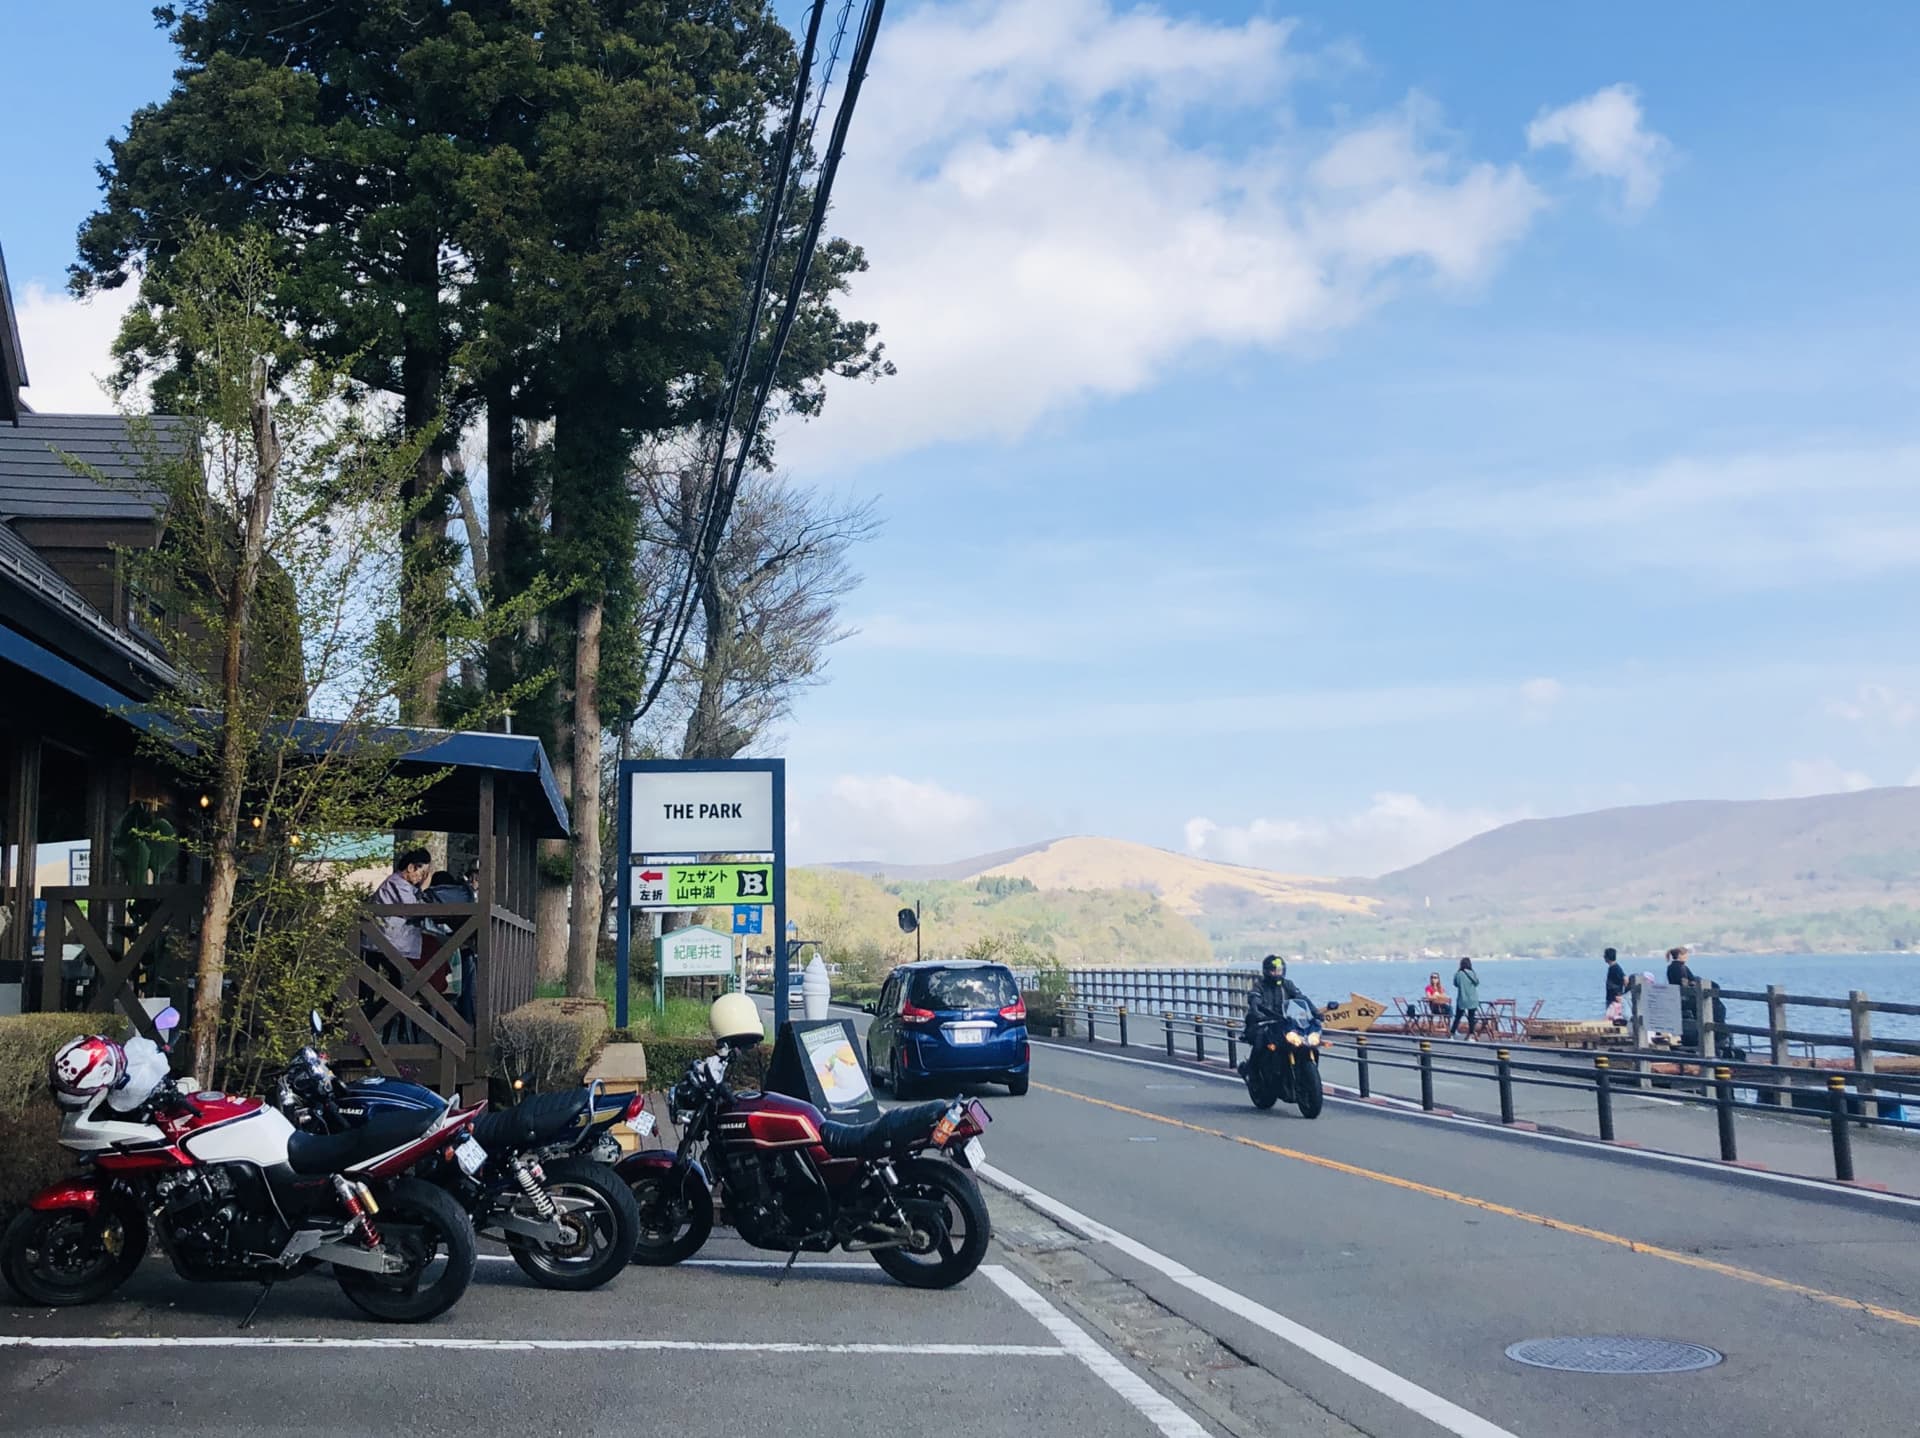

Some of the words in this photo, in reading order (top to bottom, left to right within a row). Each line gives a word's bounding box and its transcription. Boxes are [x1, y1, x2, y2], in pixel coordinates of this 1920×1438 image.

[664, 804, 695, 819] THE
[699, 803, 743, 819] PARK
[676, 870, 728, 883] フェザント
[639, 889, 663, 901] 左折
[676, 886, 716, 900] 山中湖
[673, 944, 722, 960] 紀尾井荘
